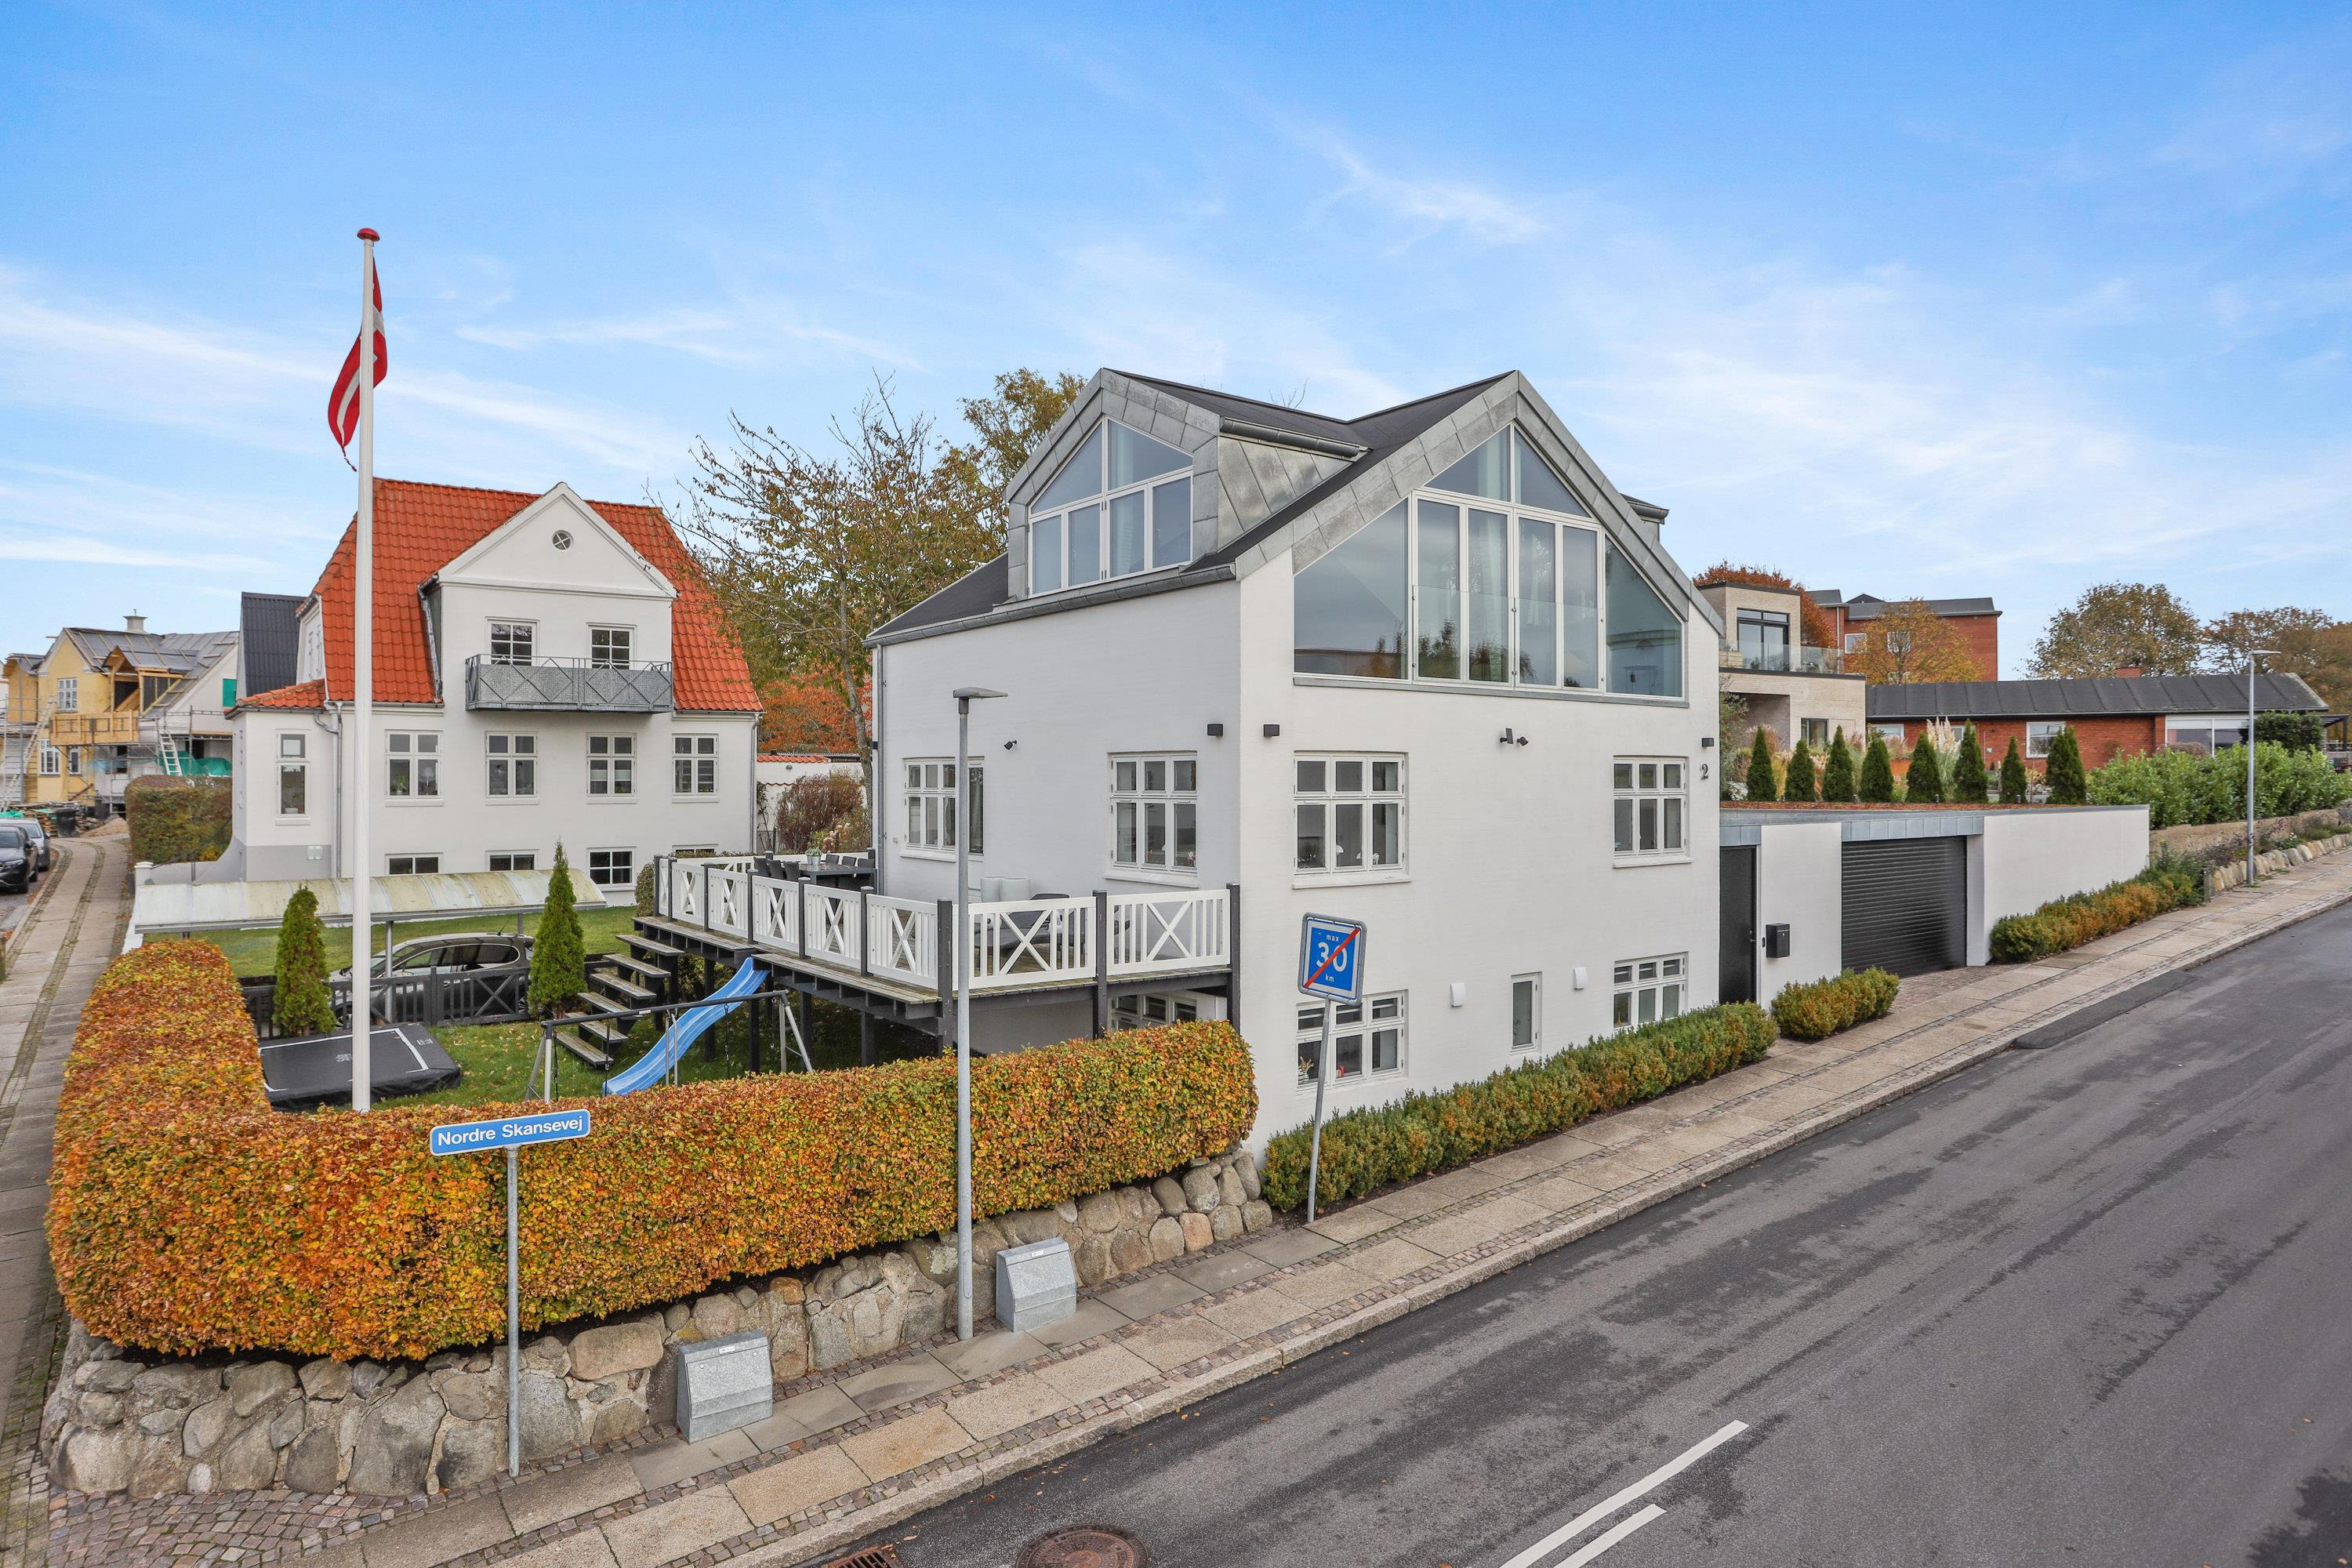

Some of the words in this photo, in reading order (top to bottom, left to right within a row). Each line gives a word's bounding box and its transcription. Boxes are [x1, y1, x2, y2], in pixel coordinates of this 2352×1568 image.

[1700, 764, 1709, 780] 2
[1316, 942, 1348, 972] 30
[1325, 974, 1334, 982] km
[437, 1127, 496, 1146] Nordre
[501, 1116, 583, 1138] Skansevej
